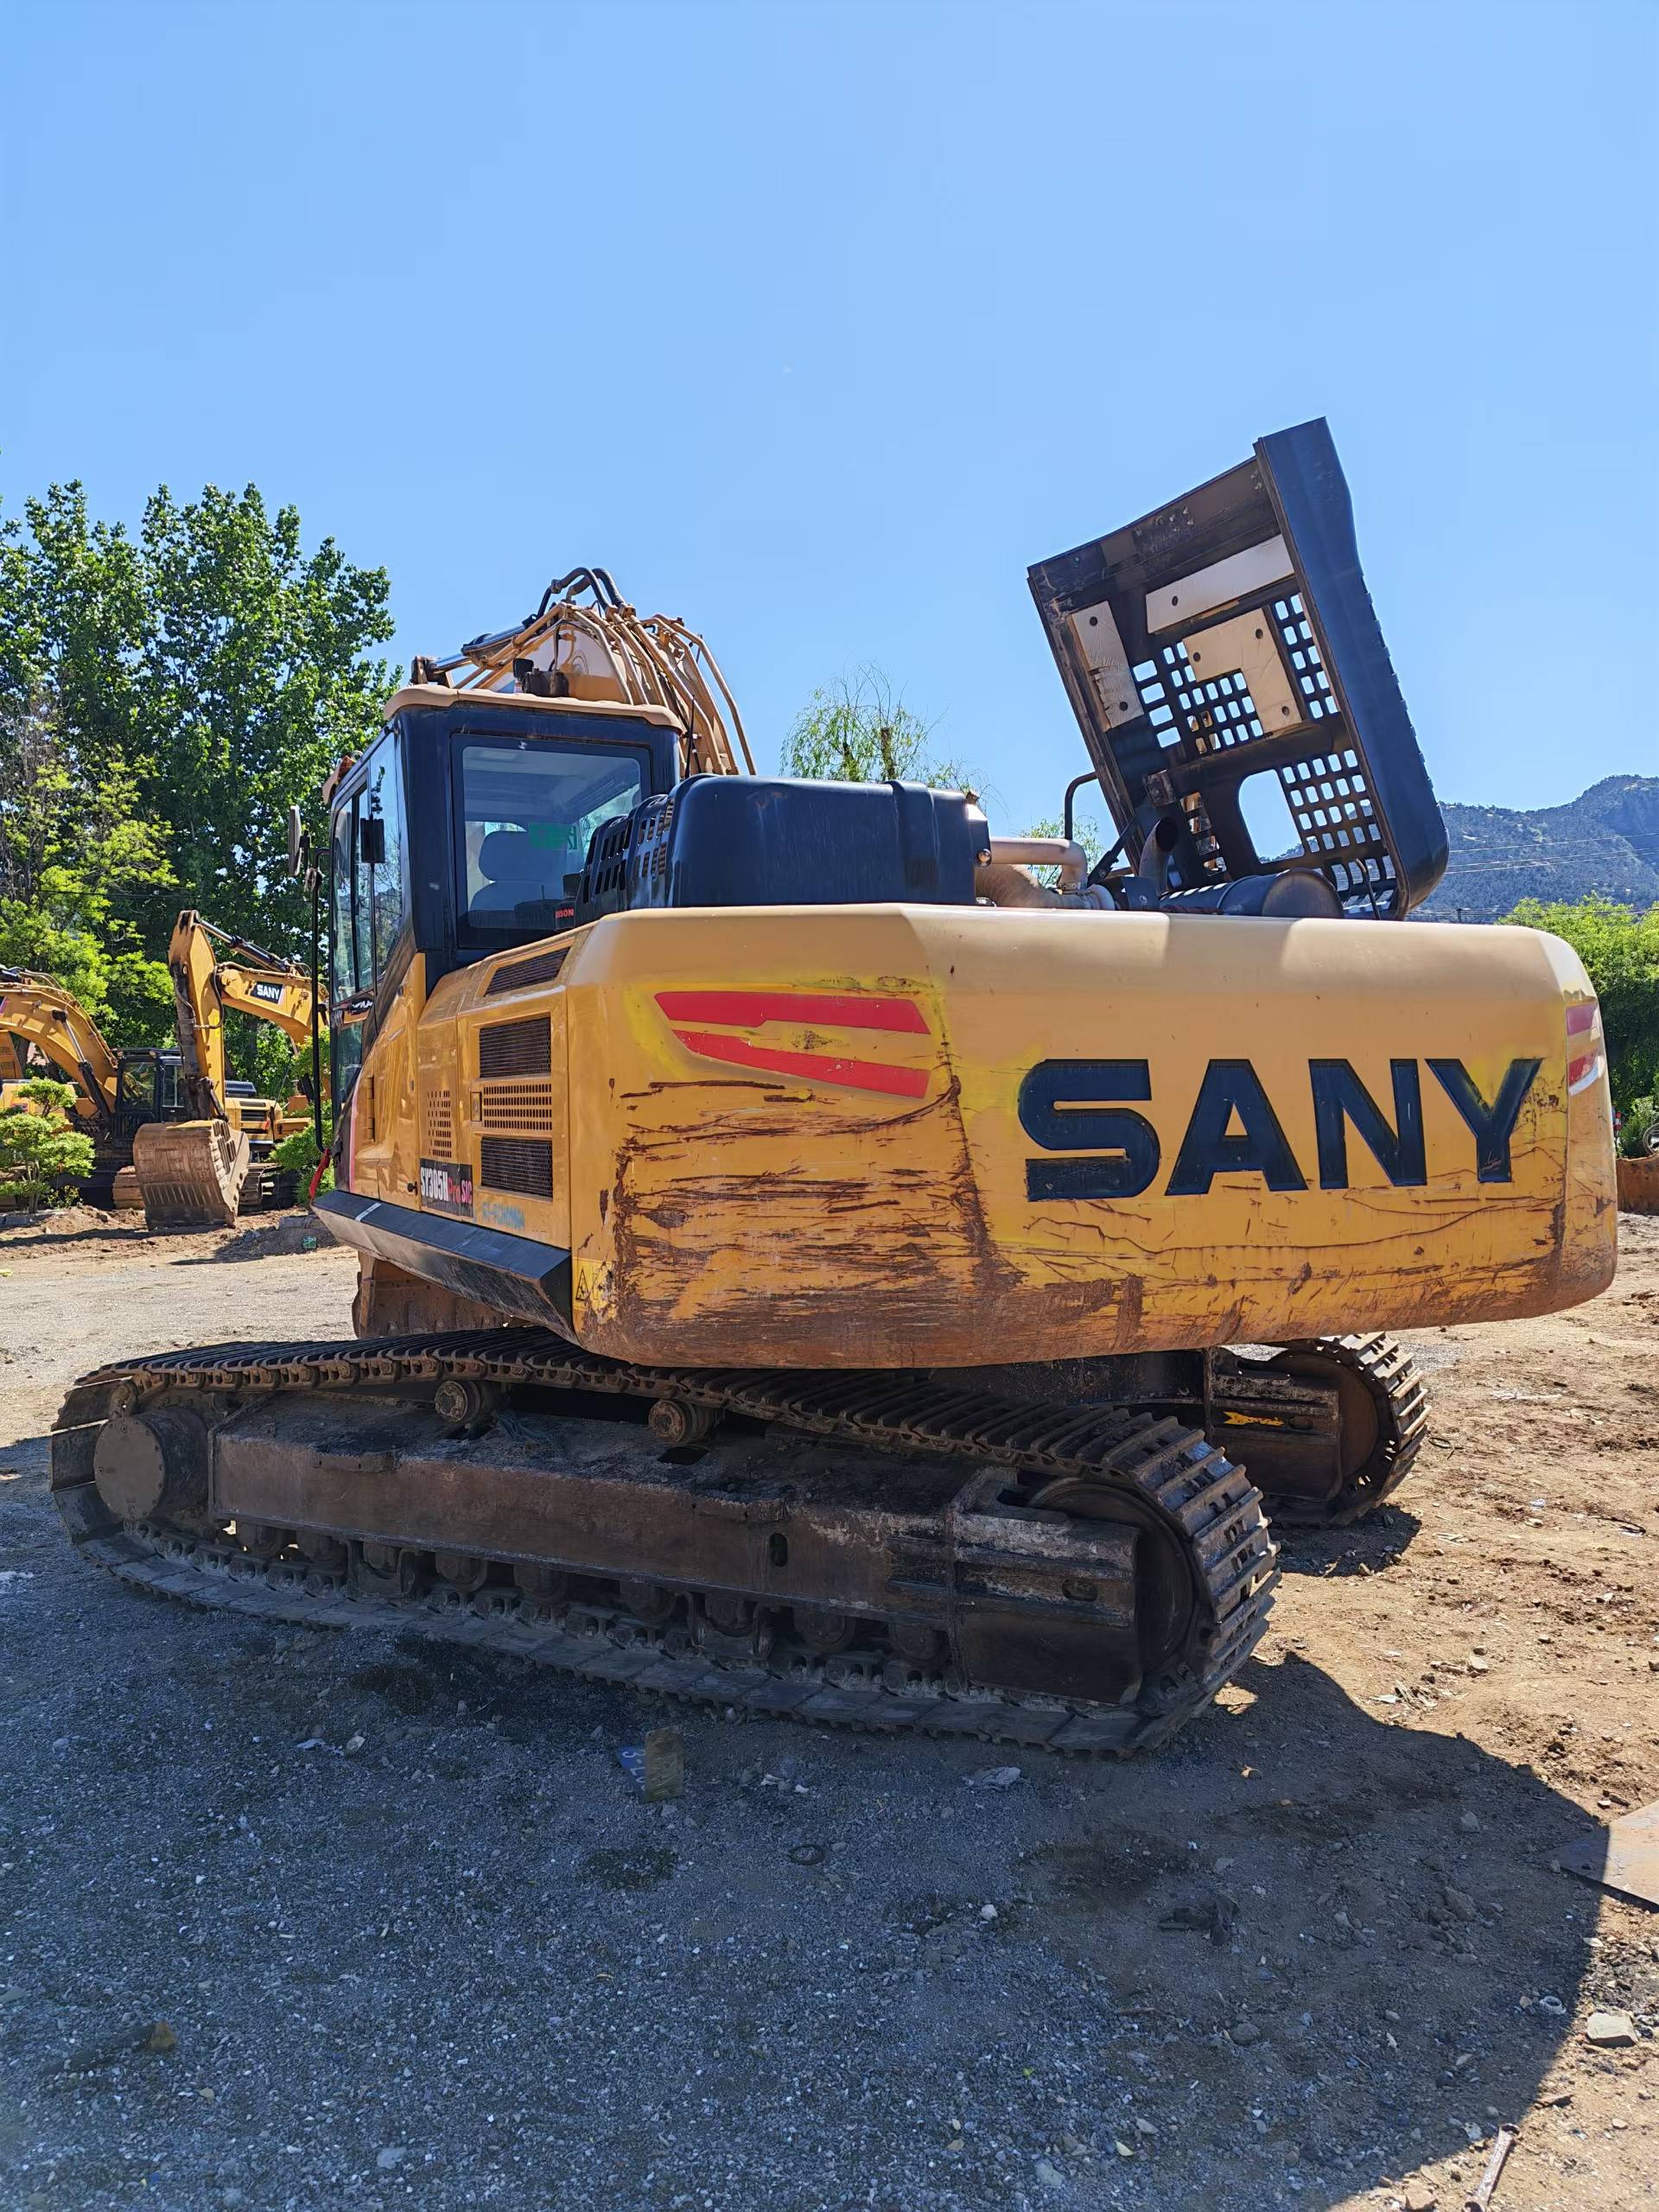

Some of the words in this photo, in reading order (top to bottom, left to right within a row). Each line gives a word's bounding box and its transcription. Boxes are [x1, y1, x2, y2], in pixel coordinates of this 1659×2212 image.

[257, 984, 280, 1000] SANY
[1018, 1058, 1543, 1202] SANY
[420, 1166, 448, 1202] SY305H
